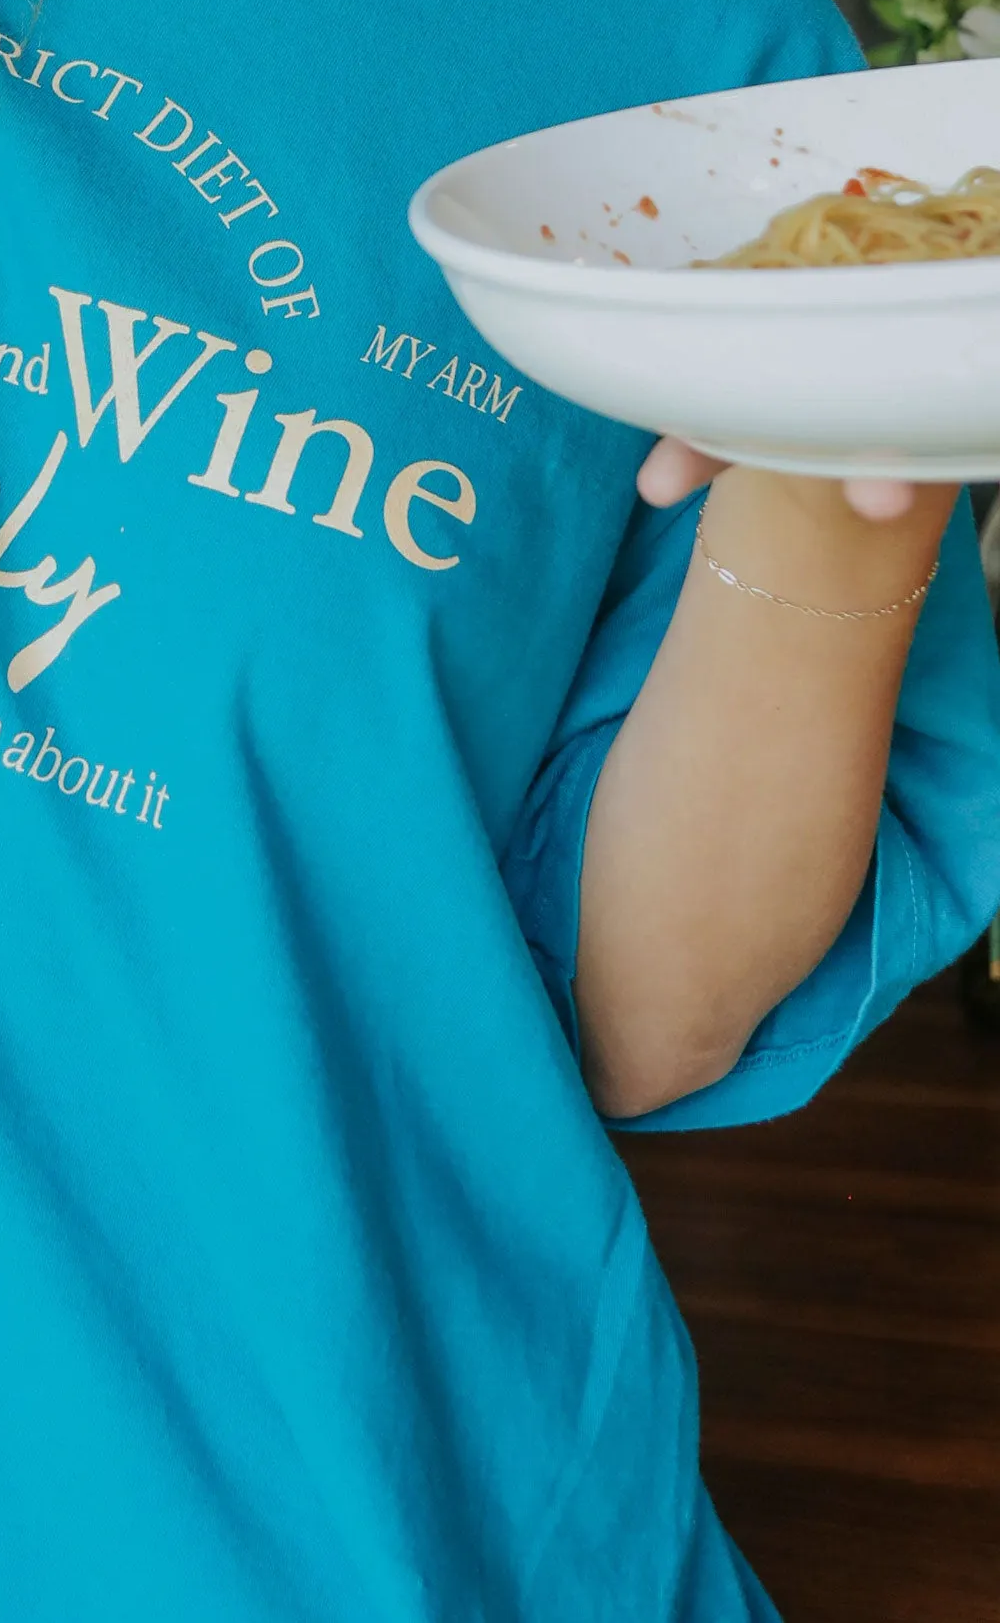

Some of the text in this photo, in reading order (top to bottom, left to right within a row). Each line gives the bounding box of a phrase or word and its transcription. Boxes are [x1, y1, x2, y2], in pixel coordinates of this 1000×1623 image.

[134, 97, 279, 229] DIET
[249, 239, 321, 319] OF
[49, 285, 477, 571] Wine
[359, 324, 523, 424] MY ARM
[2, 726, 136, 814] about
[136, 771, 171, 829] it
